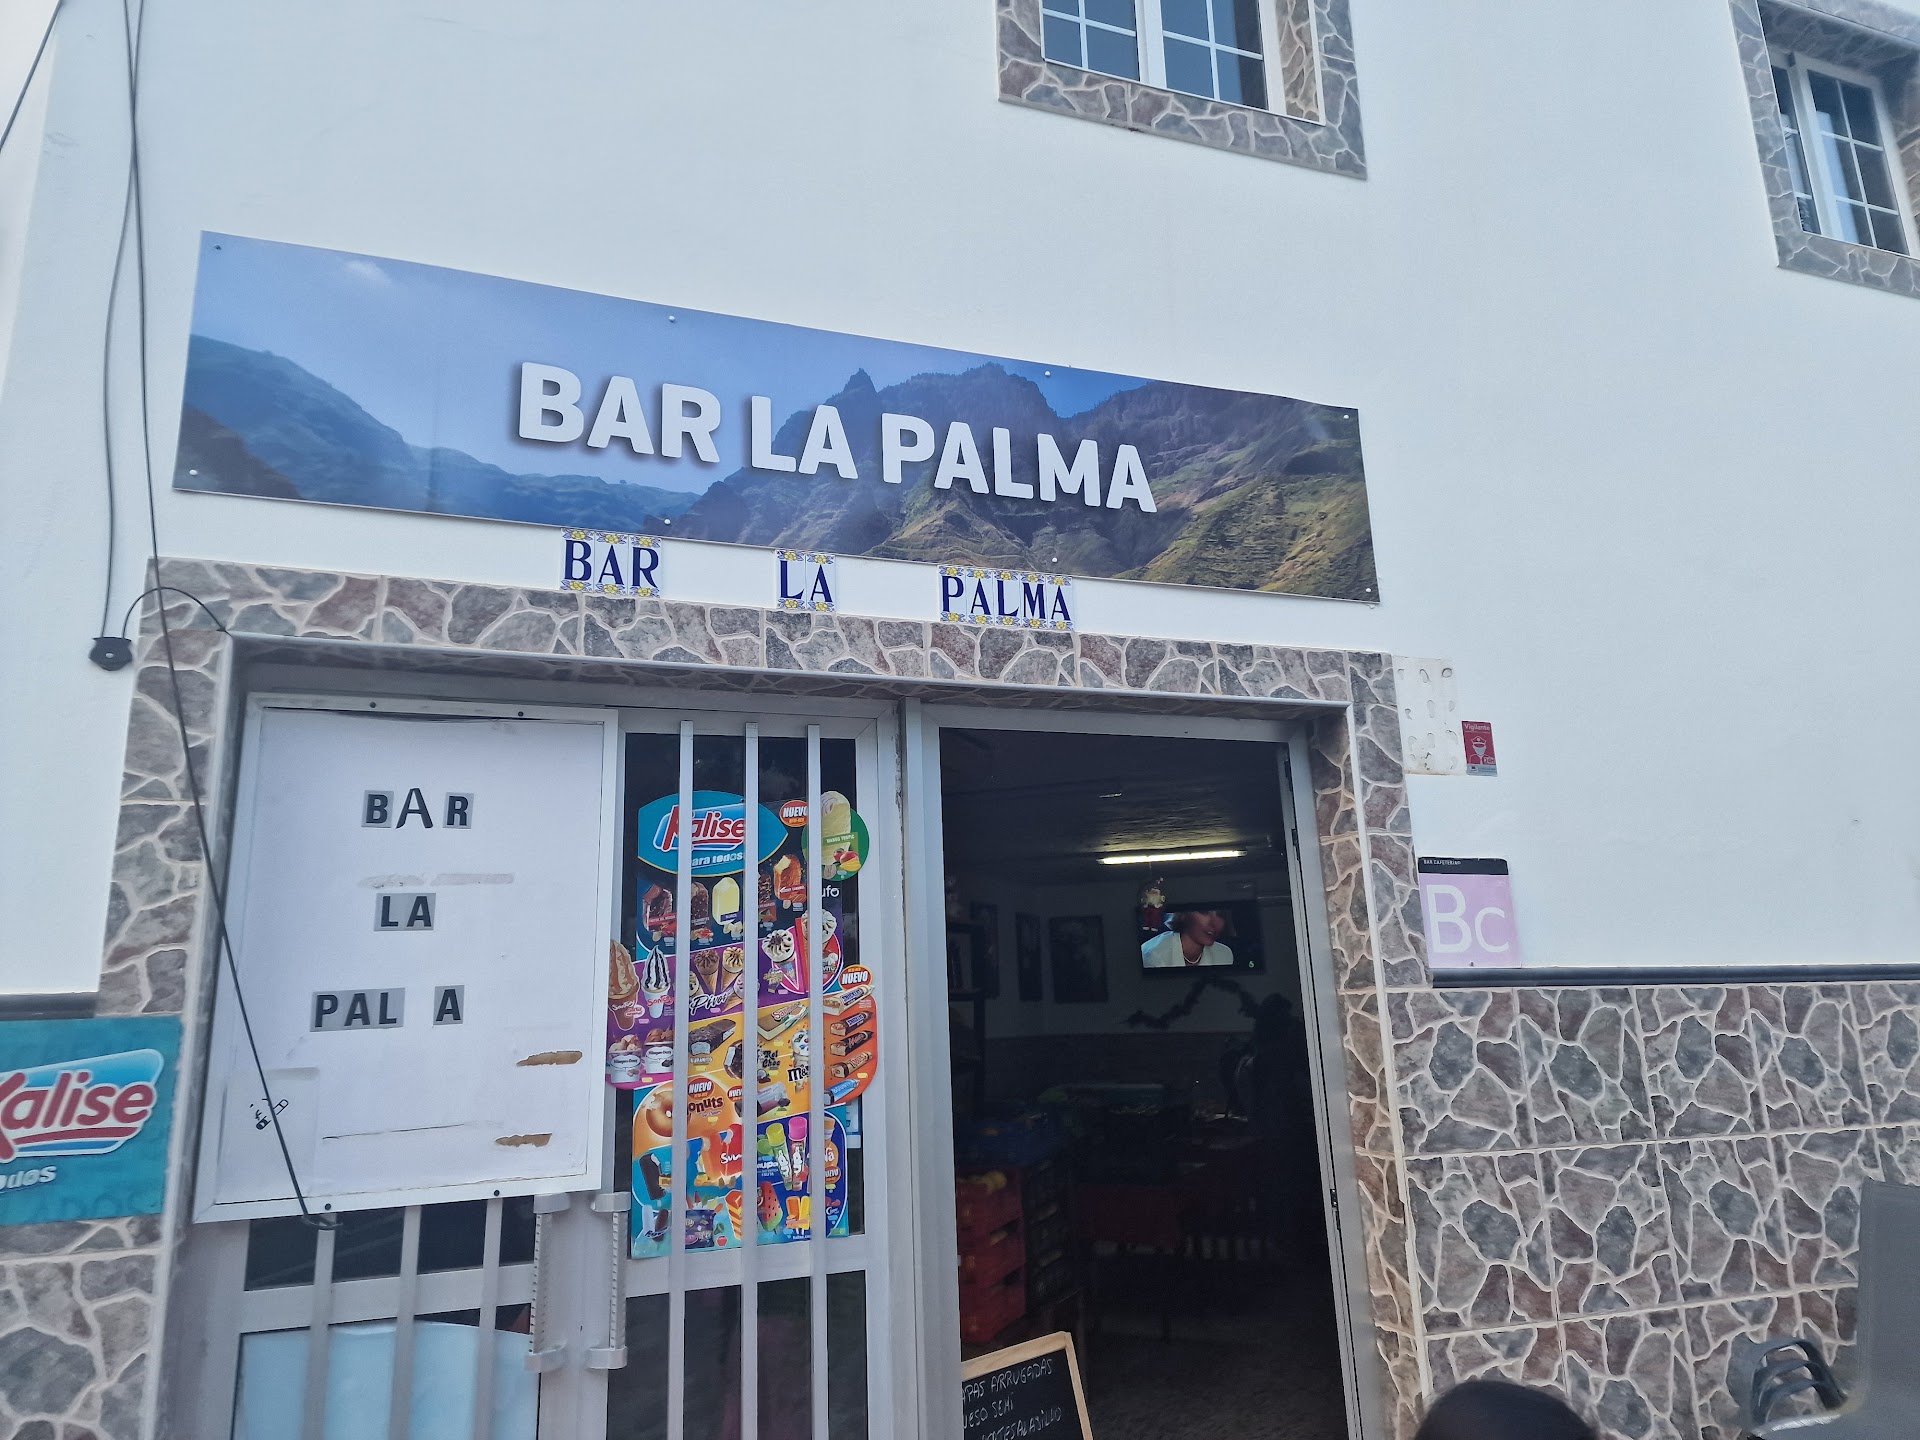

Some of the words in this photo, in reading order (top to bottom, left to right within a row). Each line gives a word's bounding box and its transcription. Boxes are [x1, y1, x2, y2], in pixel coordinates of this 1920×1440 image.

[518, 361, 721, 464] BAR
[751, 396, 857, 480] LA
[881, 412, 1157, 513] PALMA
[564, 539, 659, 588] BAR
[779, 560, 833, 602] LA
[942, 575, 1071, 621] PALMA
[365, 787, 469, 829] BAR
[380, 896, 432, 928] LA
[1426, 885, 1509, 953] Bc
[842, 971, 868, 985] NUEVO
[314, 992, 397, 1028] PAL
[435, 988, 462, 1021] A
[688, 1097, 723, 1113] onuts
[689, 1082, 711, 1093] NUEVO
[0, 1072, 154, 1161] alise
[991, 1359, 1053, 1392] ARRUGADAS
[963, 1407, 988, 1428] UESO
